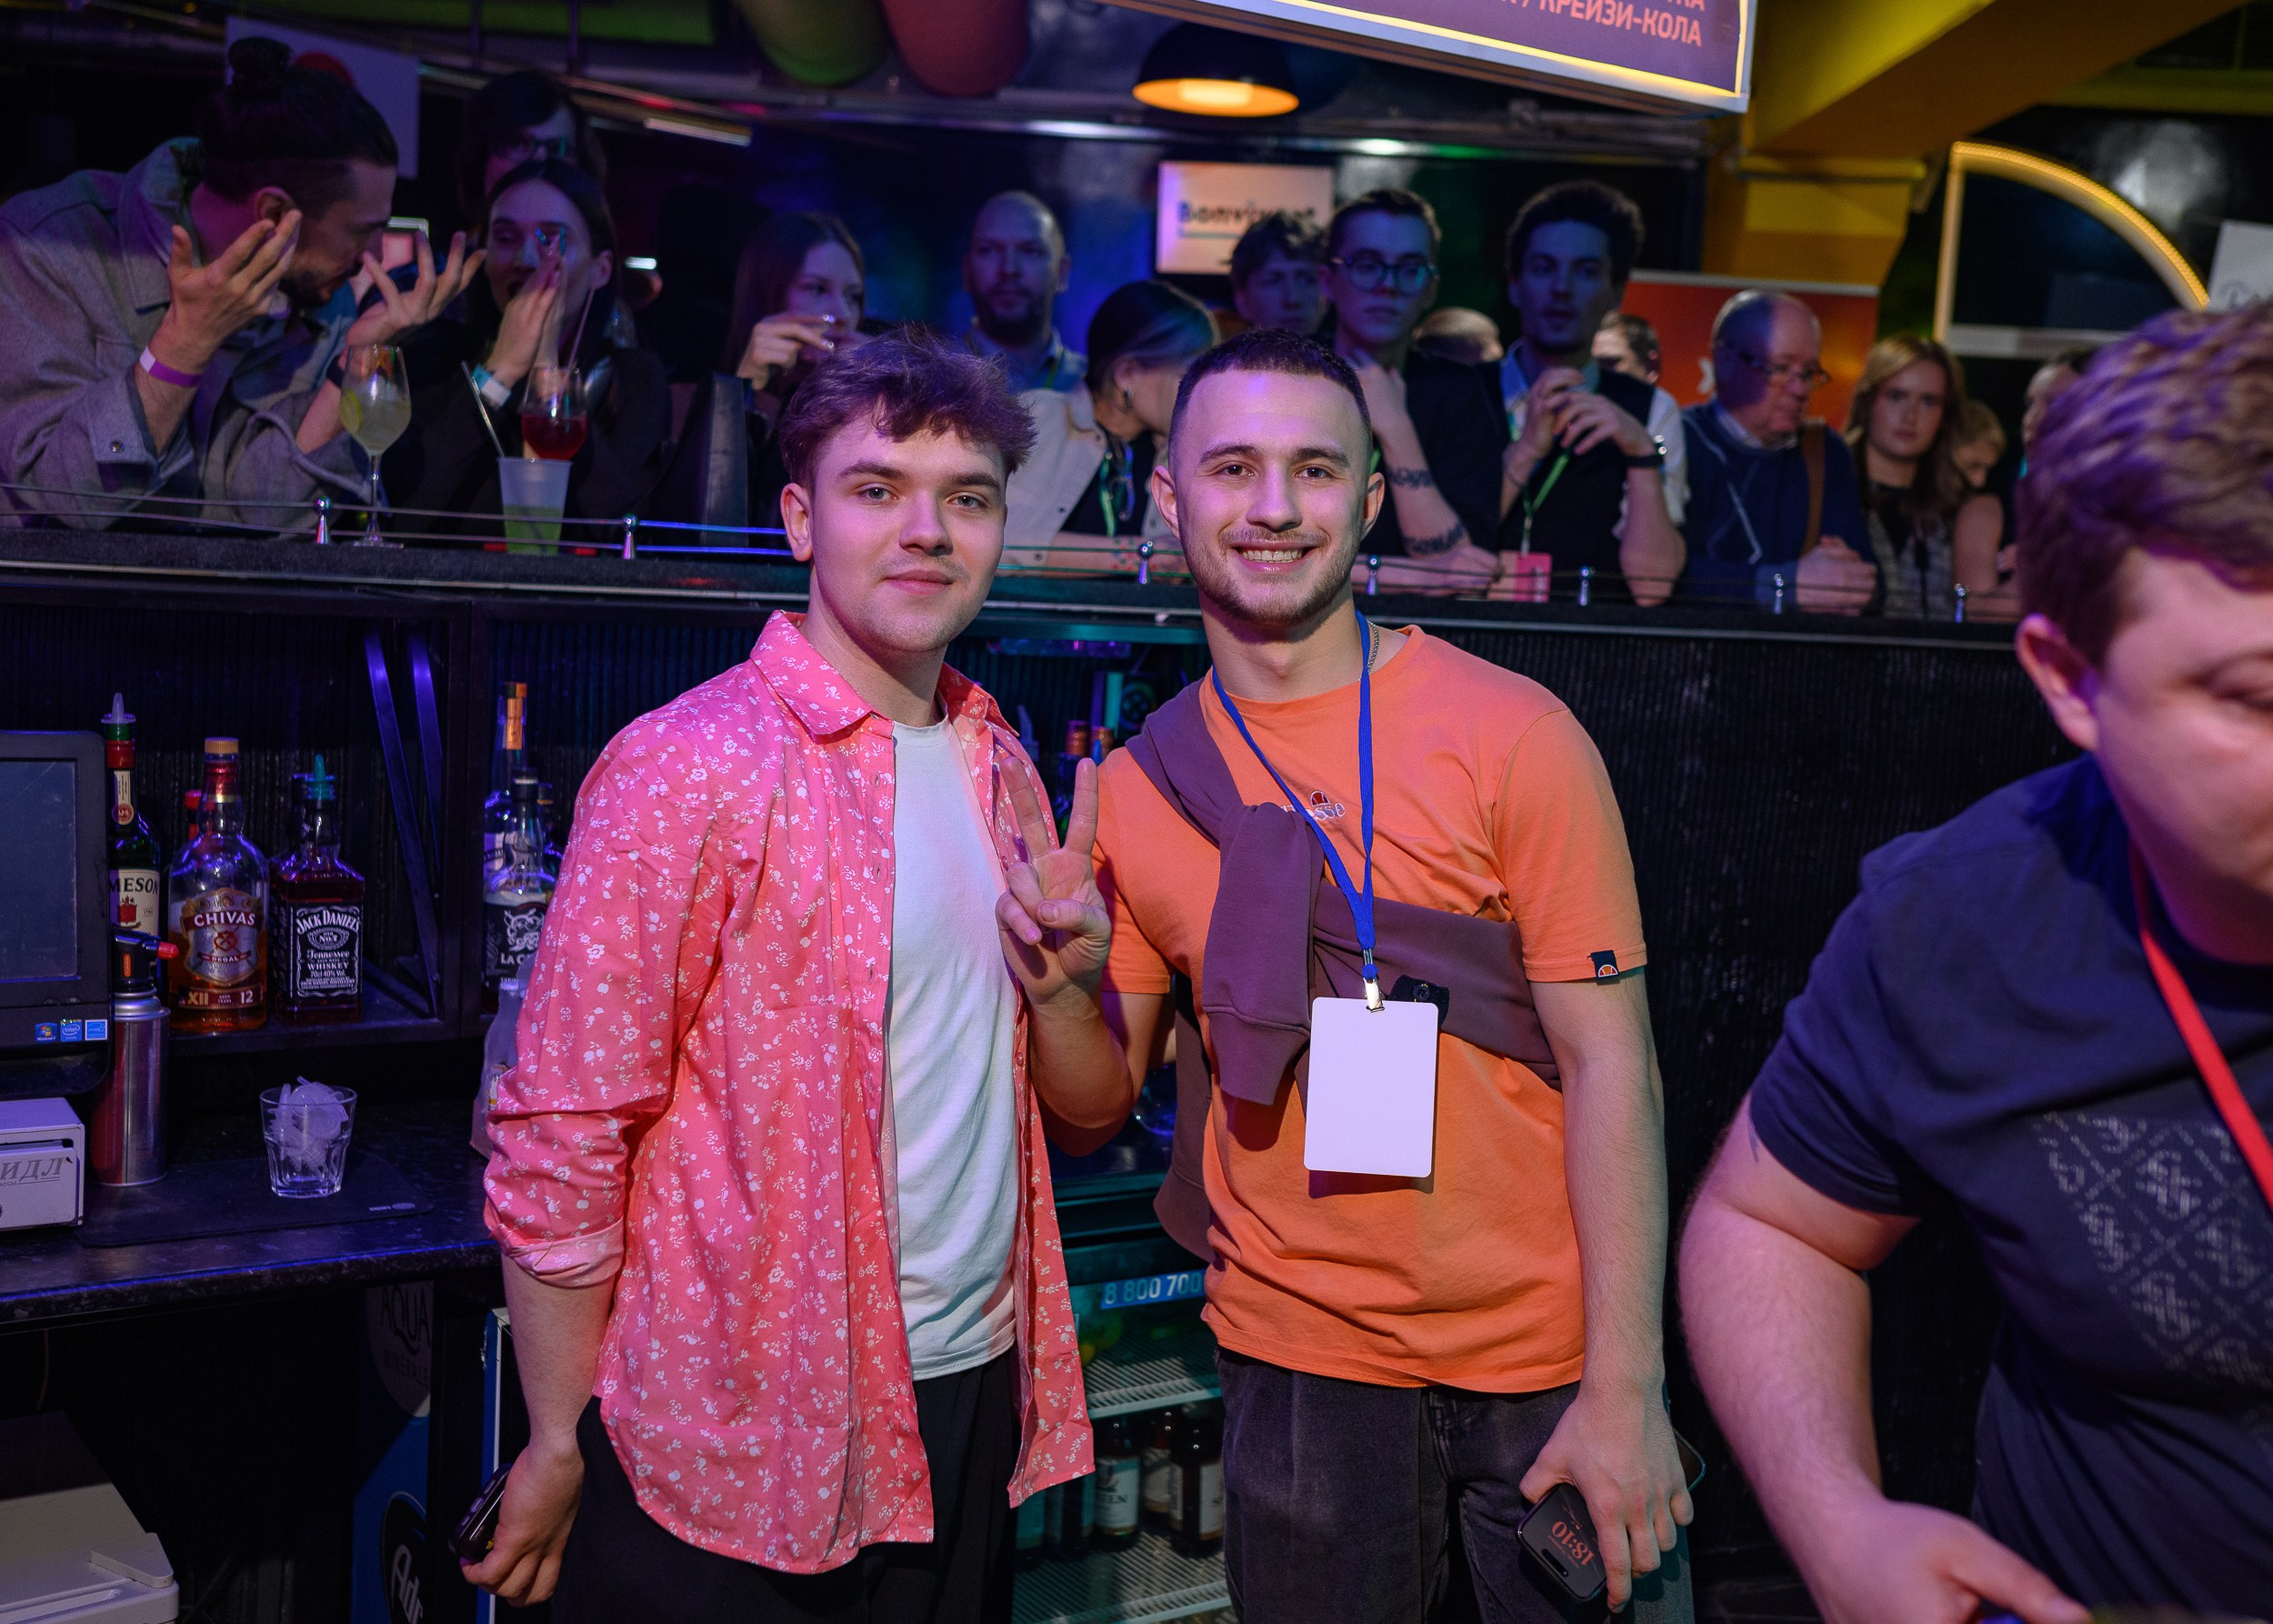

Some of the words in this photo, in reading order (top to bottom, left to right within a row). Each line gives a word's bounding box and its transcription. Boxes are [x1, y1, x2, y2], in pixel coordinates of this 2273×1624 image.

[194, 911, 255, 927] CHIVAS
[295, 913, 323, 935] JACK
[212, 955, 239, 963] REGAL
[307, 962, 349, 971] WHISKEY
[501, 952, 516, 965] LA
[187, 991, 209, 1006] XII
[240, 990, 254, 1005] 12
[1105, 1281, 1117, 1305] 8
[1123, 1277, 1162, 1302] 800
[1167, 1272, 1204, 1297] 700
[382, 1282, 432, 1355] AQUA
[1551, 1520, 1596, 1567] 18:10
